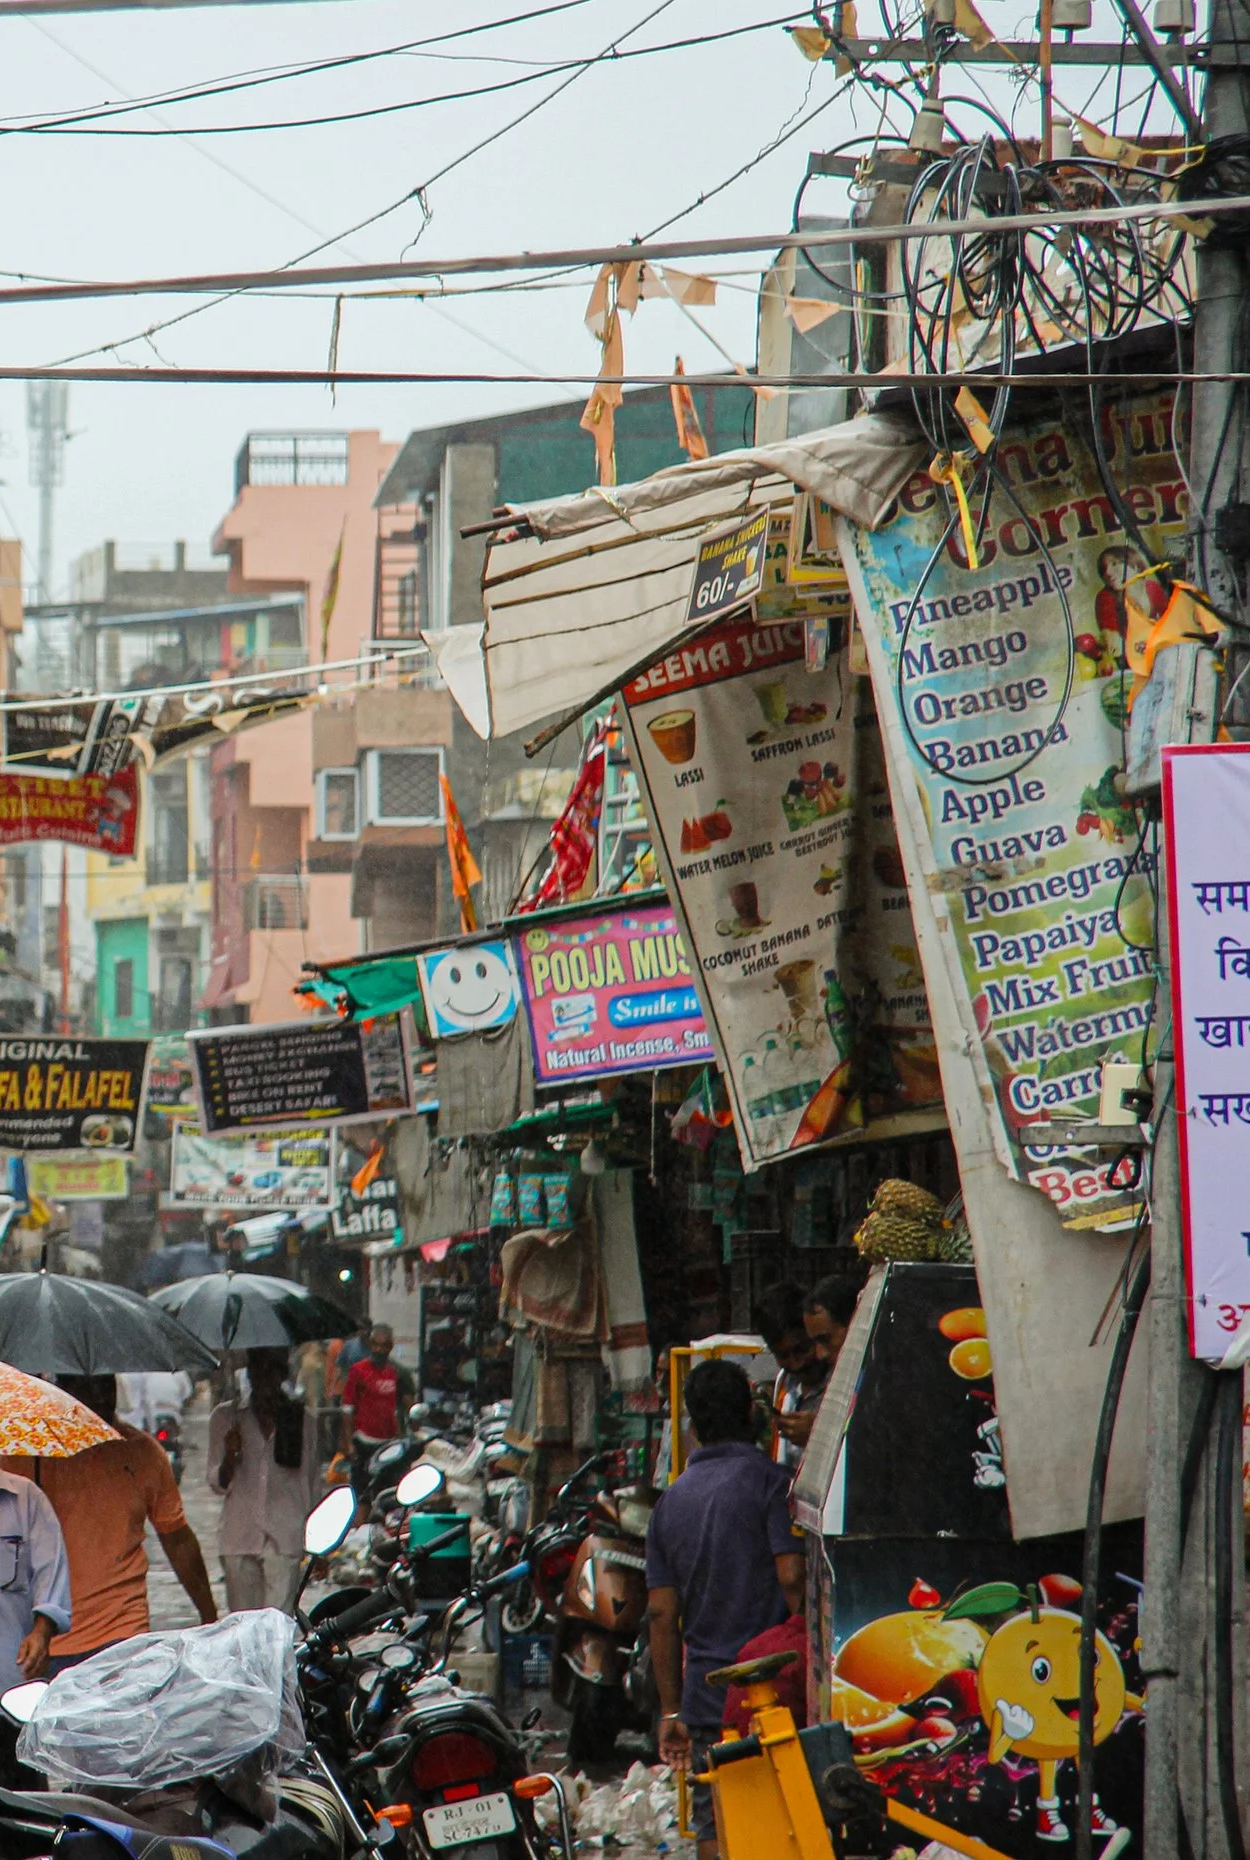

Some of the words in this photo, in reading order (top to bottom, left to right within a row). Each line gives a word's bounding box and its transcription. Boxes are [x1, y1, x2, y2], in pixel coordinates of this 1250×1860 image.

[722, 545, 748, 570] SHAKE
[696, 572, 734, 609] 60/-
[890, 561, 1073, 635] Pineapple
[903, 630, 1028, 681] Mango
[913, 676, 1048, 726] Orange
[751, 739, 803, 763] SAFFRON
[806, 727, 836, 748] LASSI
[926, 720, 1069, 775] Banana
[674, 767, 704, 788] LASSI
[942, 774, 1046, 823] Apple
[677, 860, 712, 880] WATER
[712, 849, 746, 871] MELON
[747, 841, 775, 863] JUICE
[950, 824, 1067, 866] Guava
[702, 944, 757, 971] COCONUT
[761, 924, 810, 951] BANANA
[973, 909, 1119, 968] Papaiya
[530, 942, 625, 997] POOJA
[743, 952, 780, 976] SHAKE
[985, 978, 1059, 1015] Mix
[1063, 945, 1153, 994] Fruit
[613, 997, 676, 1022] Smile
[546, 1043, 607, 1070] Natural
[610, 1035, 680, 1061] Incense,
[24, 1063, 43, 1110] &
[44, 1062, 136, 1111] FALAFEL
[229, 1101, 283, 1117] DESERT
[285, 1094, 339, 1109] SAFARI
[1036, 1154, 1135, 1206] Best
[332, 1204, 398, 1238] Laffa
